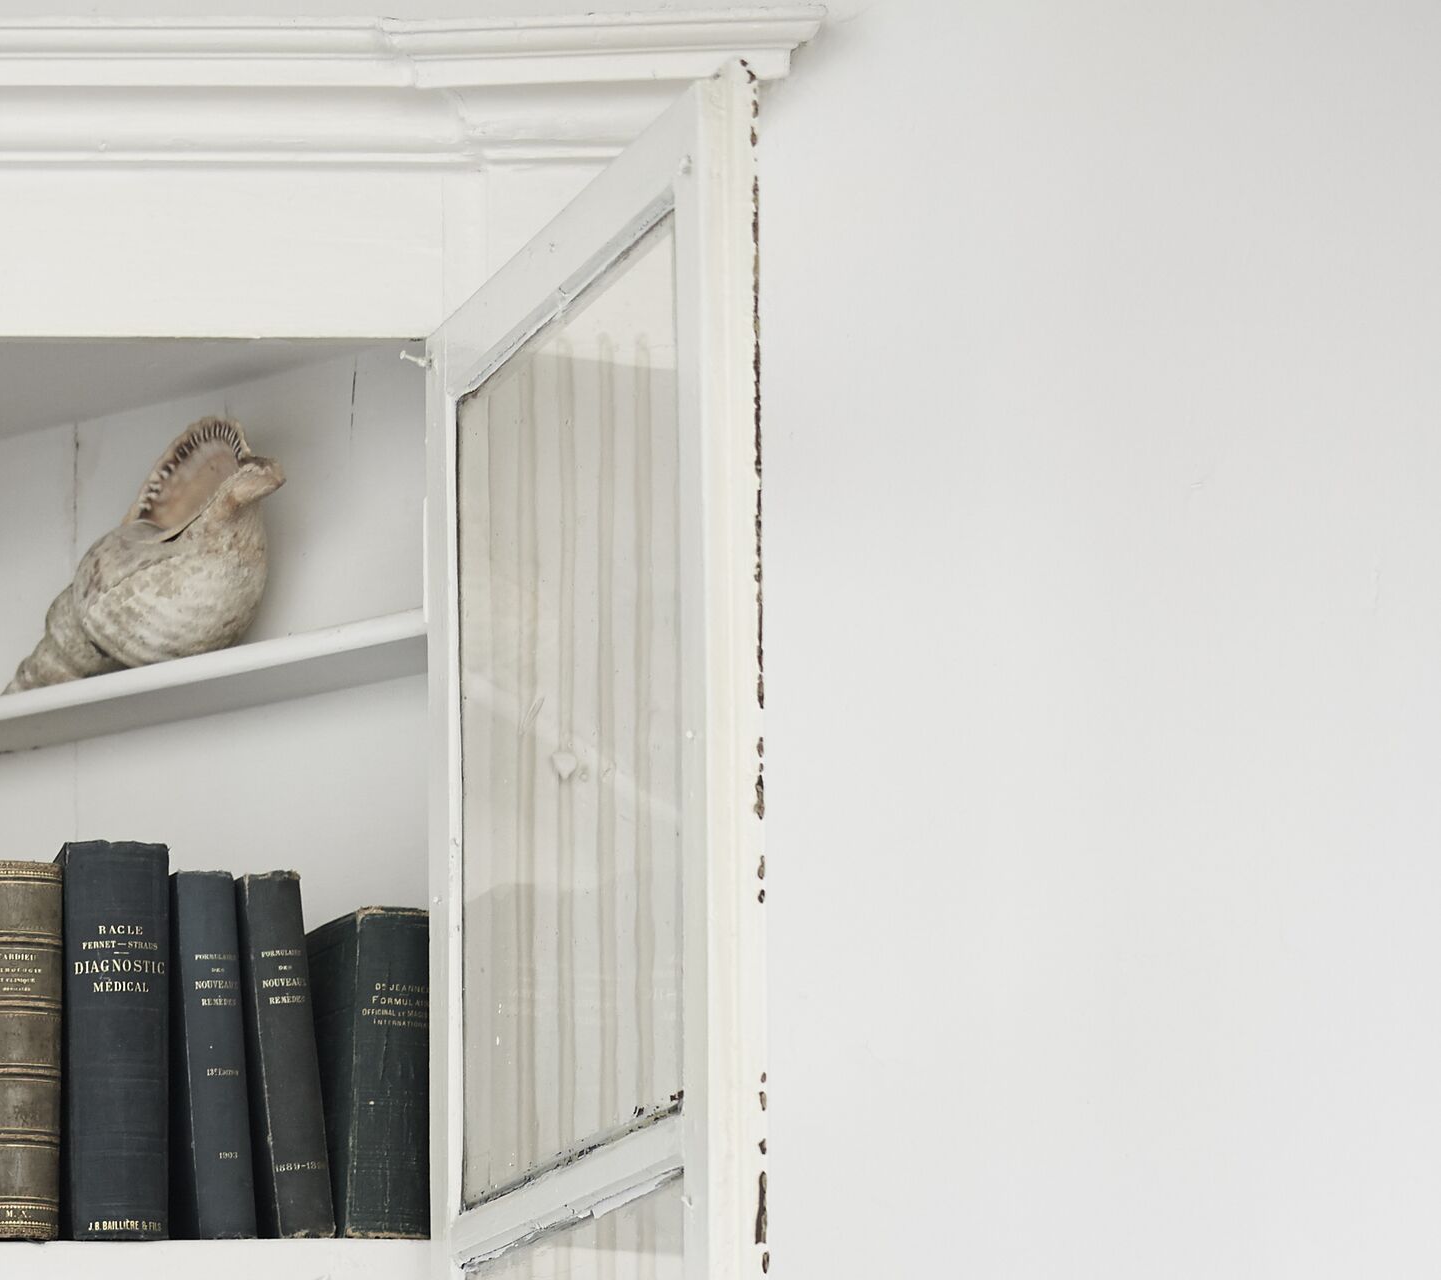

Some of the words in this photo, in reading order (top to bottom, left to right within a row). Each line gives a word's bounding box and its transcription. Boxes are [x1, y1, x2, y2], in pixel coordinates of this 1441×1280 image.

[98, 925, 143, 935] RACLE
[74, 959, 165, 975] DIAGNOSTIC
[93, 977, 149, 992] MÉDICAL
[389, 983, 430, 993] JEANNE
[219, 1151, 238, 1159] 1903
